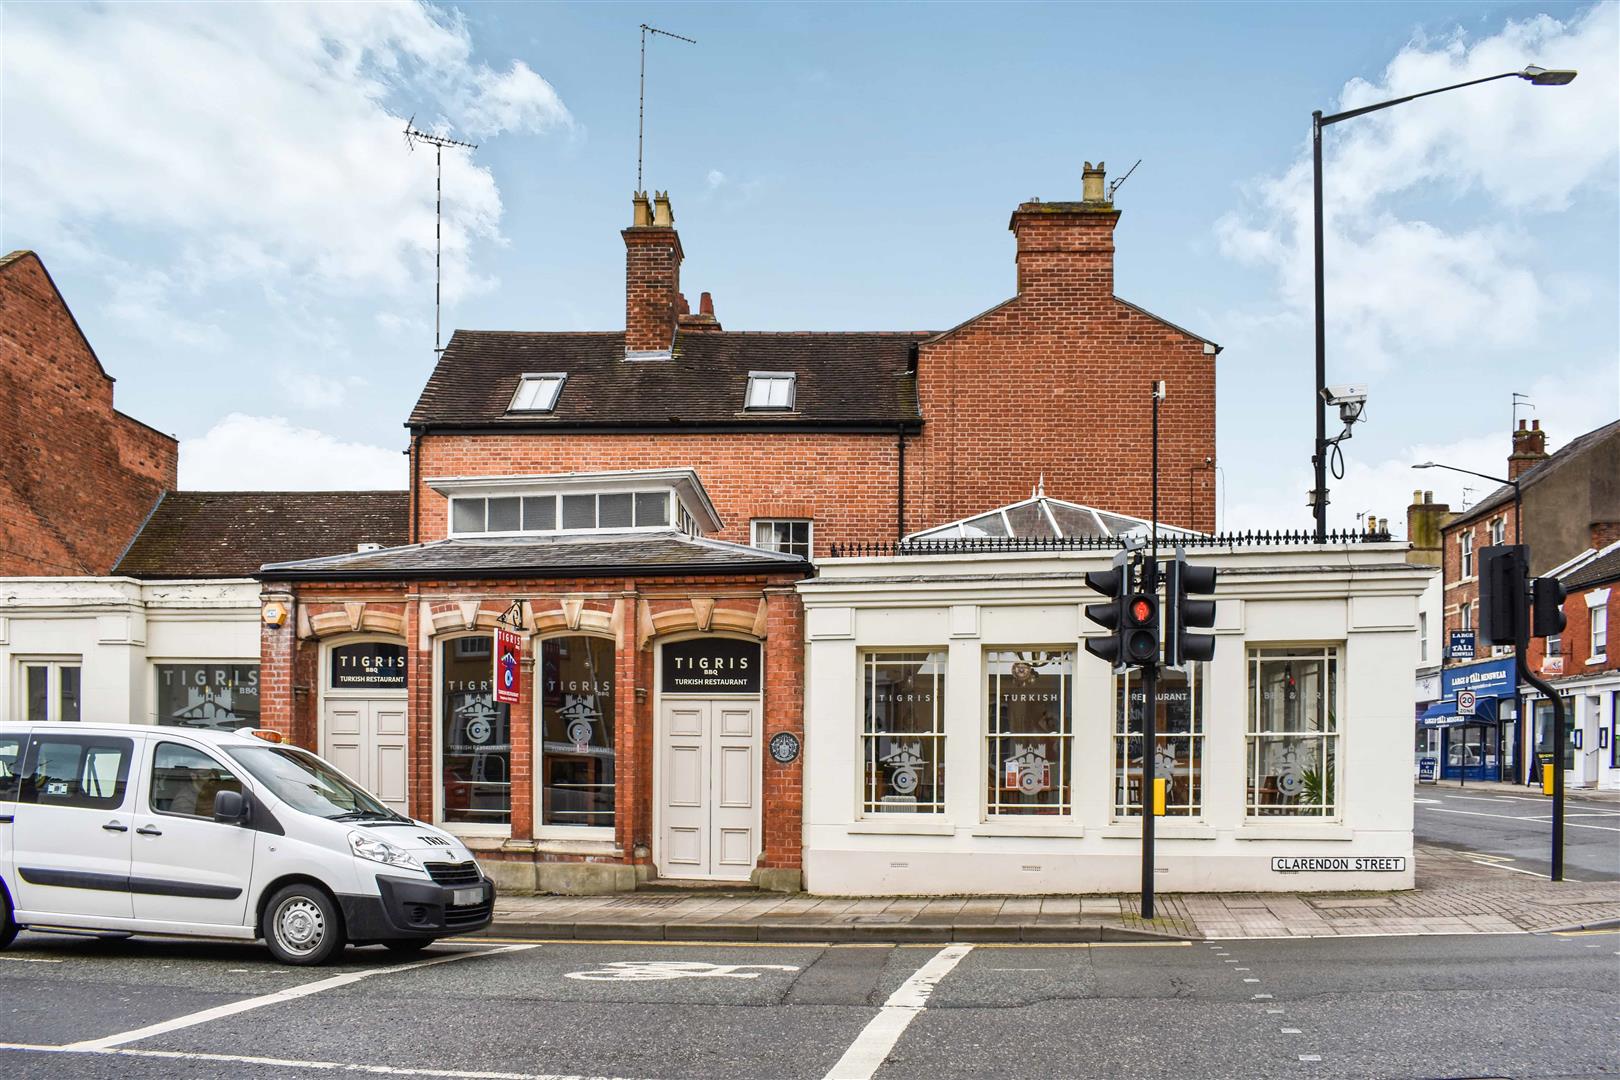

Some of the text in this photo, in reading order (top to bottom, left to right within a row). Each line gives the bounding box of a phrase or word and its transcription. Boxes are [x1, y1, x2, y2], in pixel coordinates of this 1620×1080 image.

[498, 631, 520, 645] TIGRIS
[340, 656, 405, 667] TIGRIS
[675, 657, 748, 669] TIGRIS
[163, 670, 258, 686] TIGRIS
[448, 681, 488, 690] TIGR
[548, 680, 610, 691] TIGRIS
[239, 687, 258, 695] BBQ
[879, 694, 931, 702] TIGRIS
[1003, 694, 1058, 702] TURKISH
[1131, 693, 1188, 701] REURANT
[417, 836, 451, 846] TAXI
[1277, 858, 1400, 870] CLARENDON STREET
